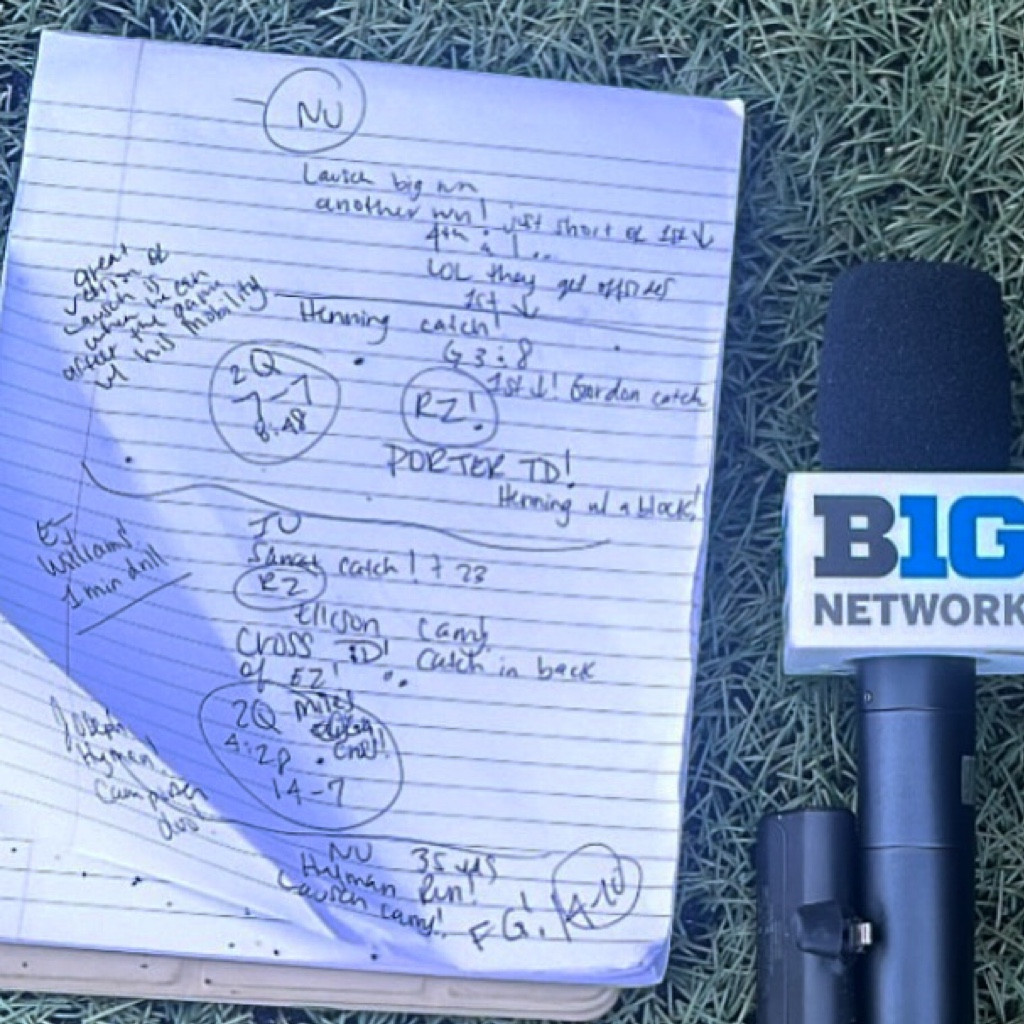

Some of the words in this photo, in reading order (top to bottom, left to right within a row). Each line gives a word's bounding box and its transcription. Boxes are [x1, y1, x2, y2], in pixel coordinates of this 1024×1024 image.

[298, 98, 343, 128] NU
[391, 171, 422, 202] big
[315, 195, 420, 219] another
[428, 257, 473, 281] LOL
[383, 443, 505, 478] PORTER
